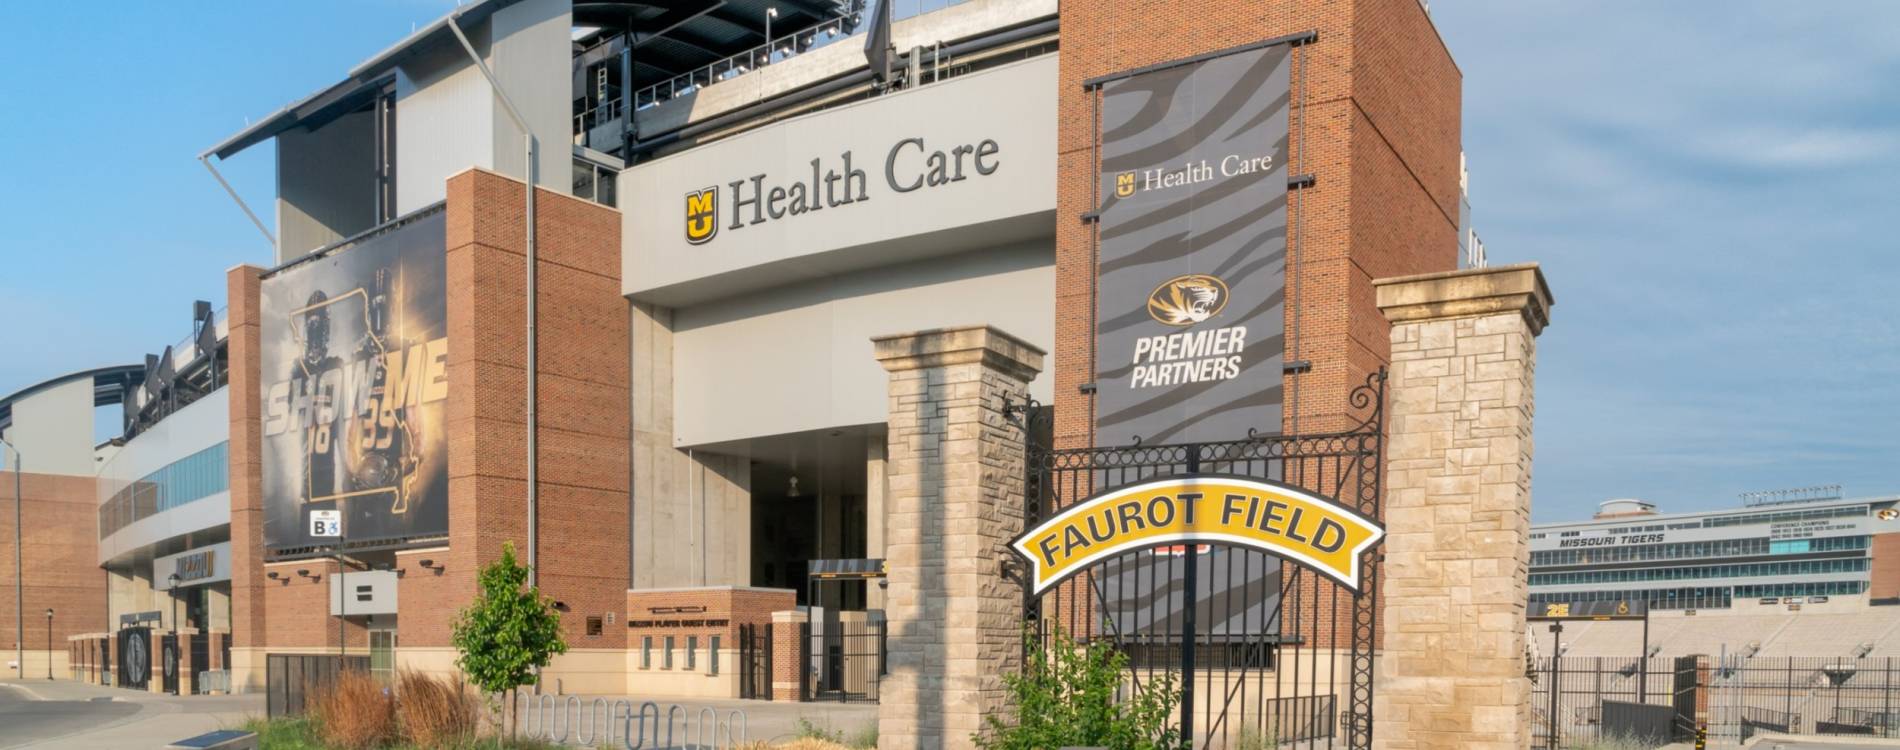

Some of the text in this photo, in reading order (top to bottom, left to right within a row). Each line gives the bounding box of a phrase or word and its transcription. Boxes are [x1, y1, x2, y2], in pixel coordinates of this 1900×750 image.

[728, 150, 869, 230] Health
[885, 138, 999, 193] Care
[1143, 160, 1213, 191] Health
[1221, 154, 1273, 178] Care
[1133, 326, 1246, 364] PREMIER
[265, 337, 448, 437] SHOW ME
[1130, 355, 1242, 389] PARTNERS
[314, 521, 326, 535] B
[1038, 493, 1346, 566] FAUROT FIELD
[1560, 533, 1665, 548] MISSOURI TIGERS
